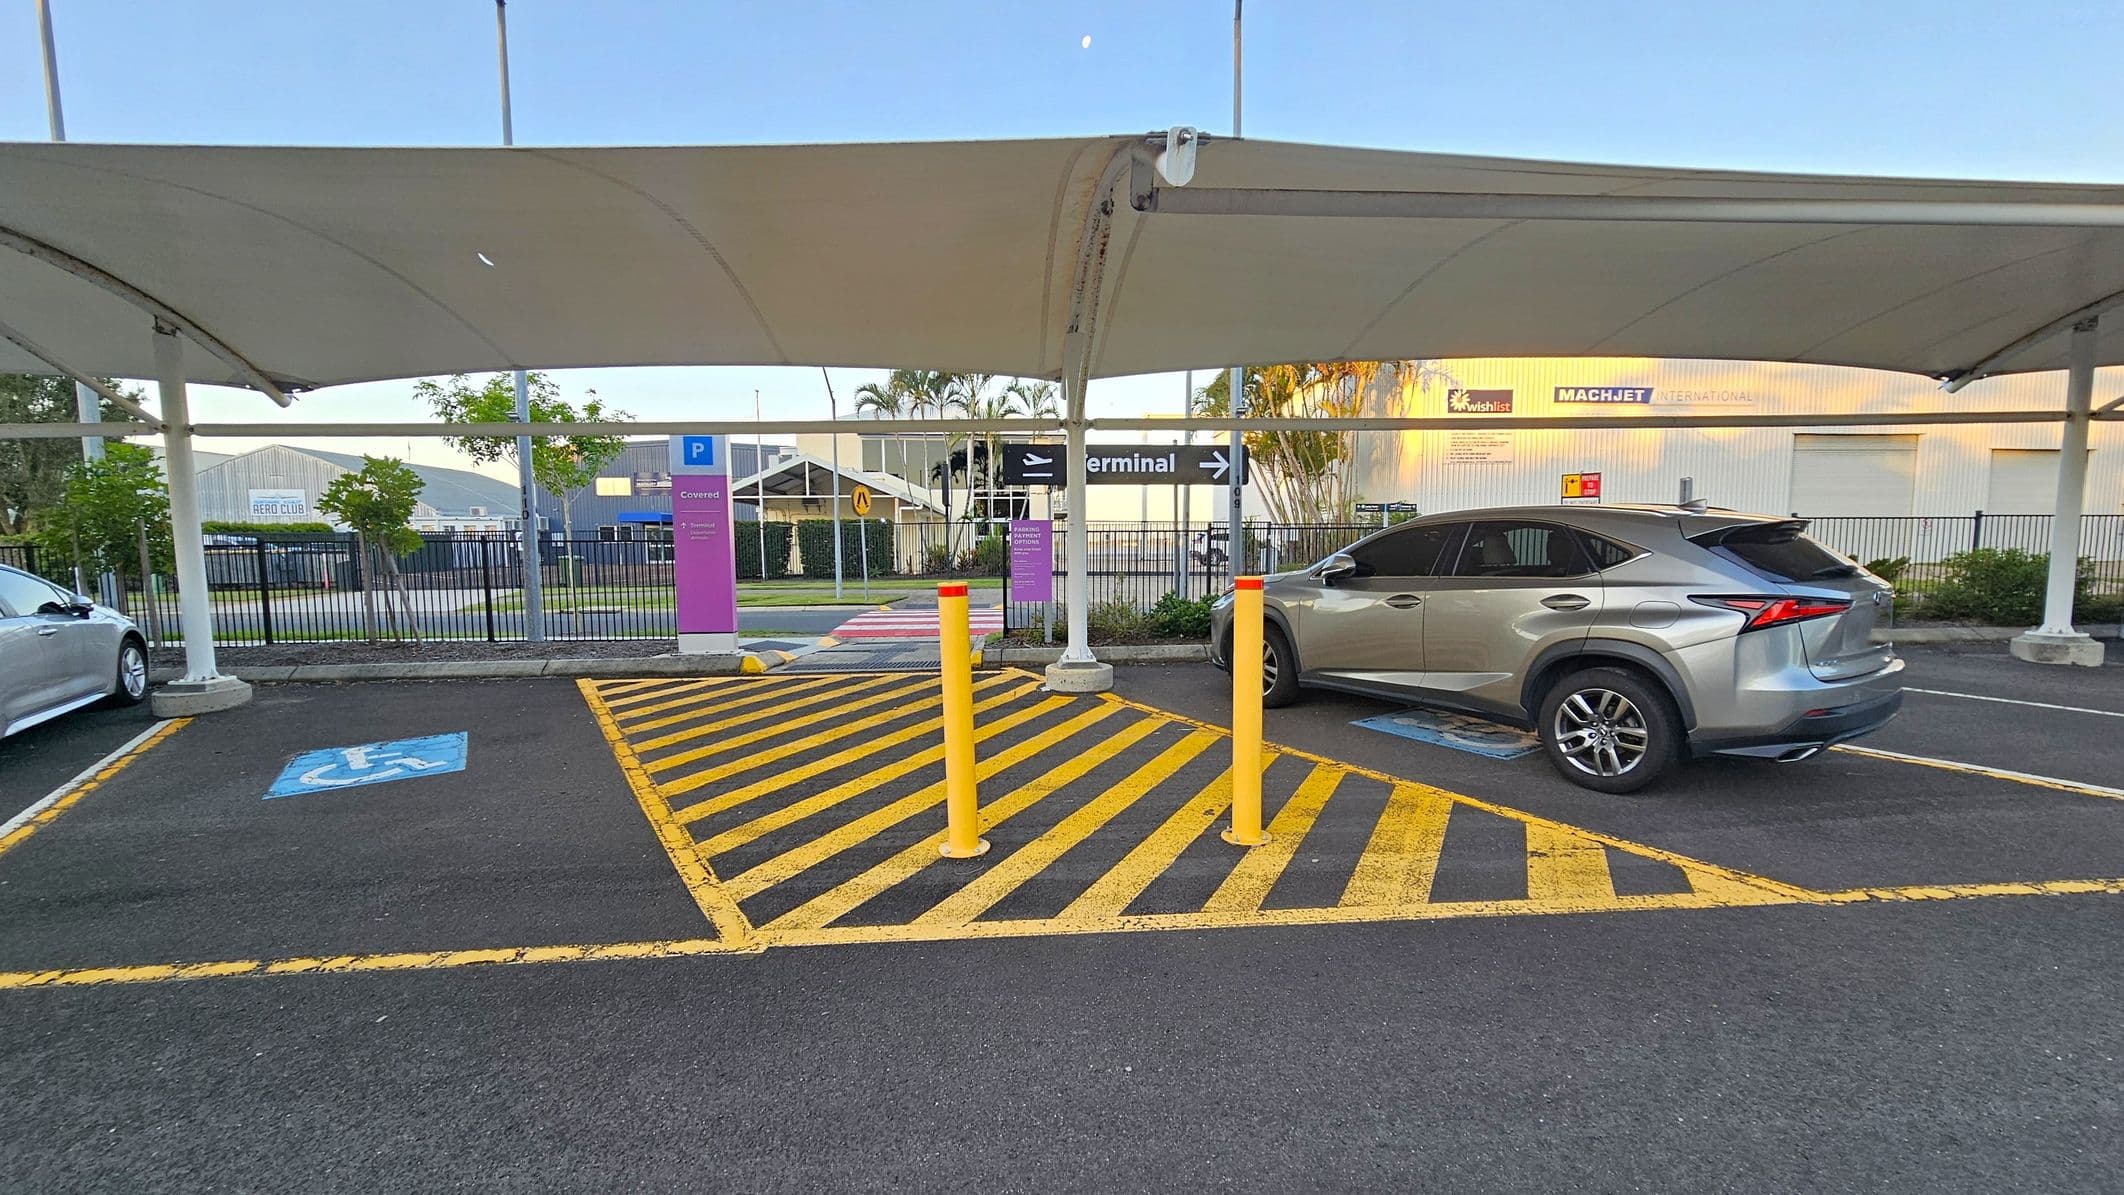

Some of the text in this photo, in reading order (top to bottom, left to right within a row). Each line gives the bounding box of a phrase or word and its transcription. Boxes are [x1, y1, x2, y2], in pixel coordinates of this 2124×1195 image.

[1559, 389, 1752, 402] MACHJET INTERNATIONAL
[1467, 401, 1511, 411] wishlist
[691, 442, 705, 459] P
[1085, 453, 1175, 473] erminal
[680, 491, 720, 499] Covered
[253, 504, 305, 515] AERO CLUB
